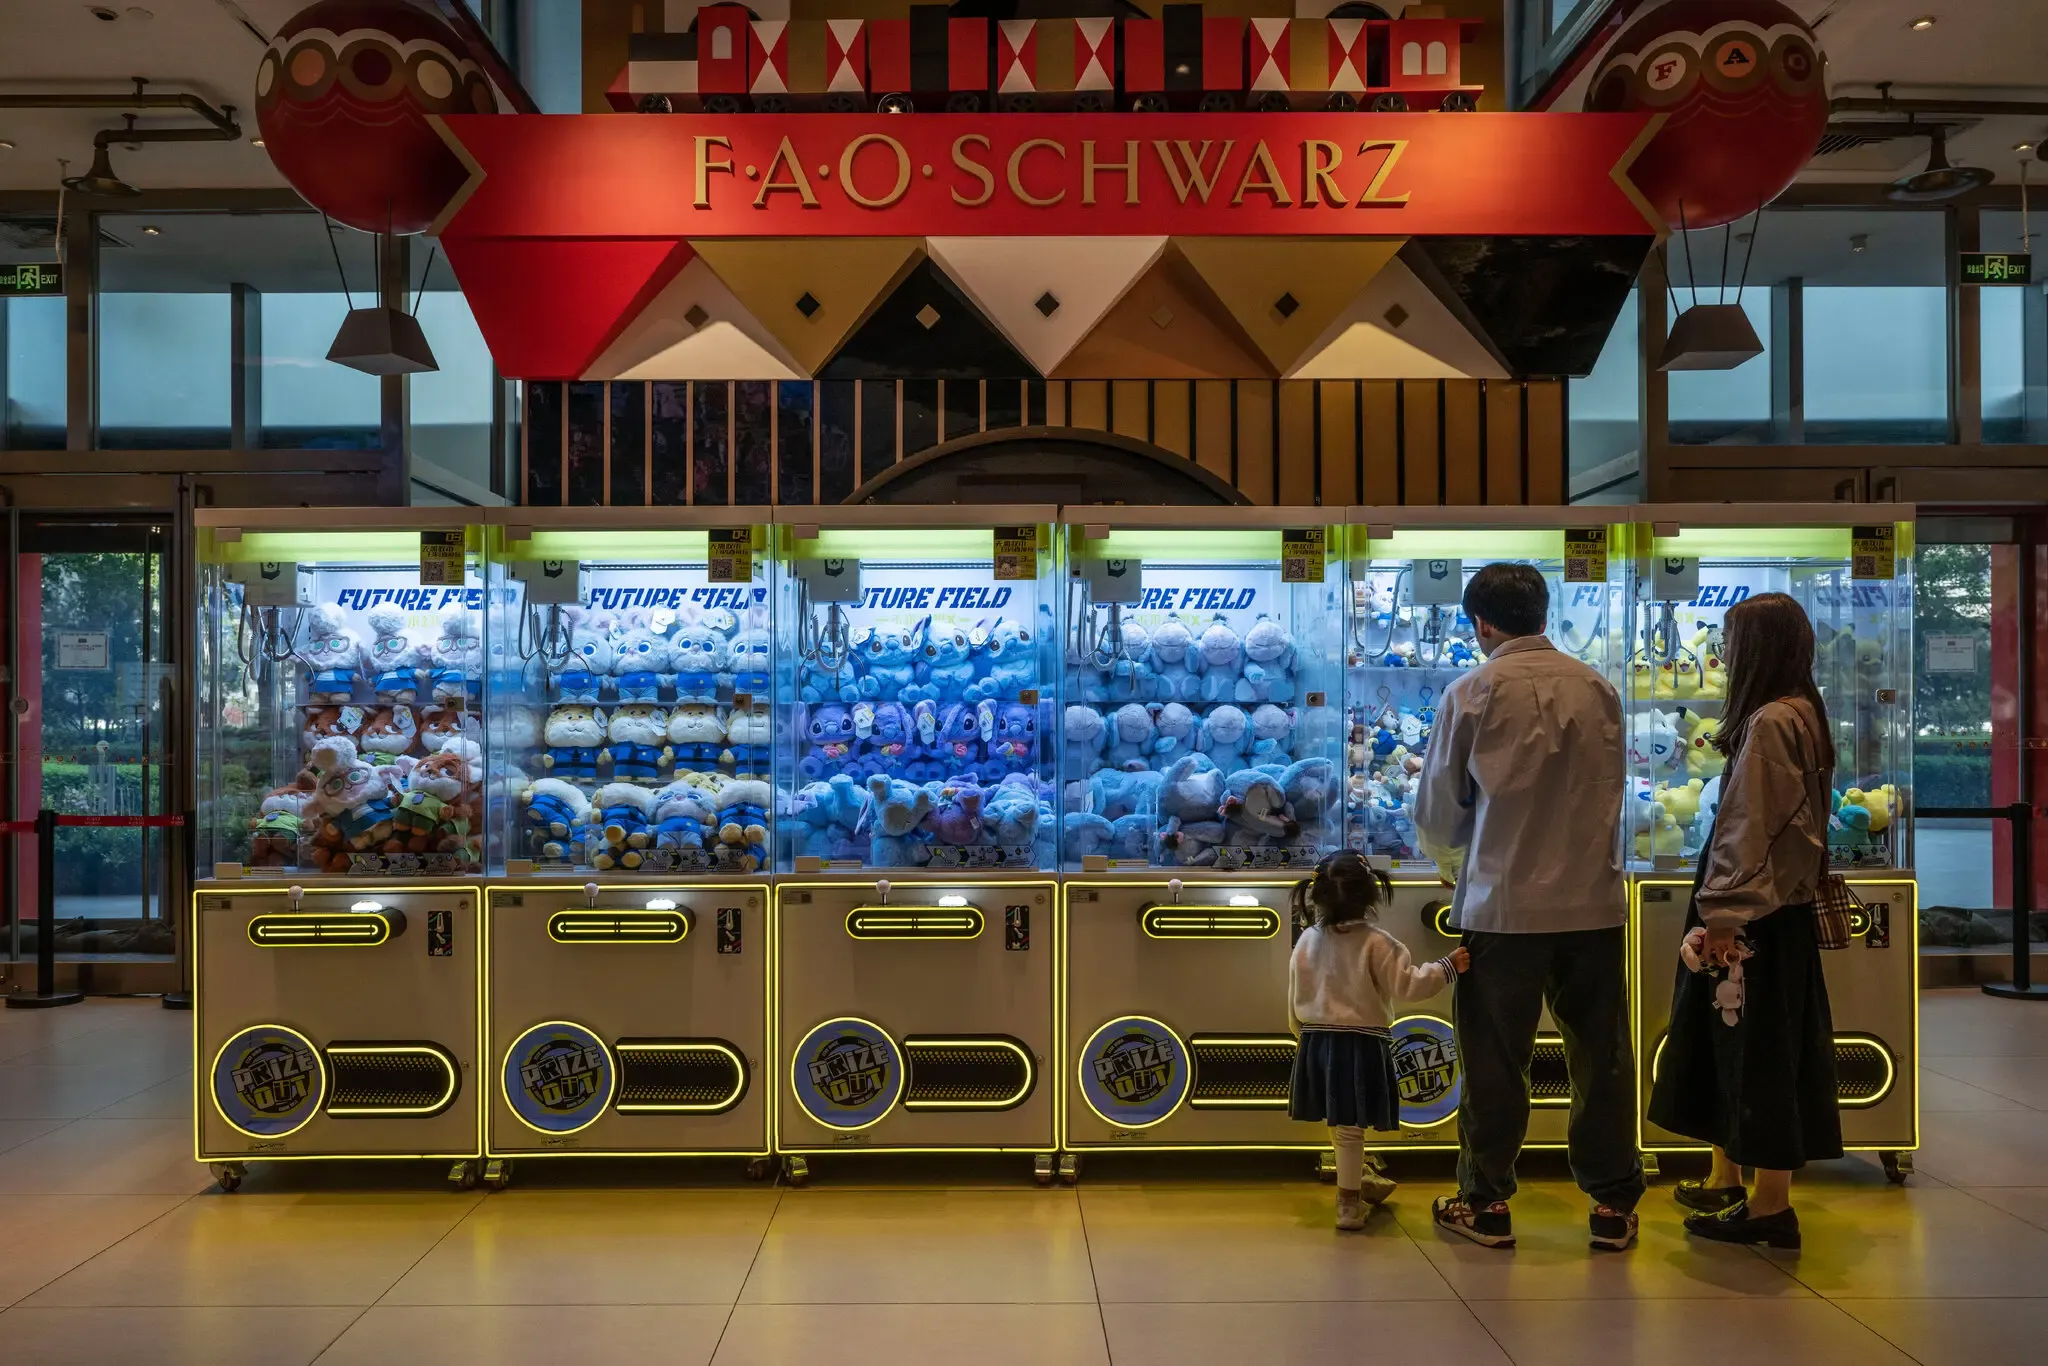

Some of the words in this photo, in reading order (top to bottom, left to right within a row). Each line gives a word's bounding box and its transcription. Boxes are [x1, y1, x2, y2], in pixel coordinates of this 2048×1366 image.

[1723, 48, 1750, 66] A
[40, 274, 58, 284] EXIT
[2008, 264, 2025, 275] EXIT
[732, 530, 748, 538] 04
[1017, 528, 1033, 536] 05
[1305, 531, 1322, 539] 06
[1875, 528, 1891, 536] 08
[337, 589, 438, 611] FUTURE
[586, 588, 687, 609] FUTURE
[851, 587, 935, 609] UTURE
[935, 587, 1012, 609] FIELD
[1179, 588, 1256, 610] FIELD
[1687, 585, 1750, 607] IELD
[520, 1045, 603, 1089] PRIZE
[808, 1041, 890, 1086] PRIZE
[1093, 1039, 1175, 1082] PRIZE
[1393, 1038, 1458, 1076] RIZE
[232, 1048, 315, 1093] PRIZE
